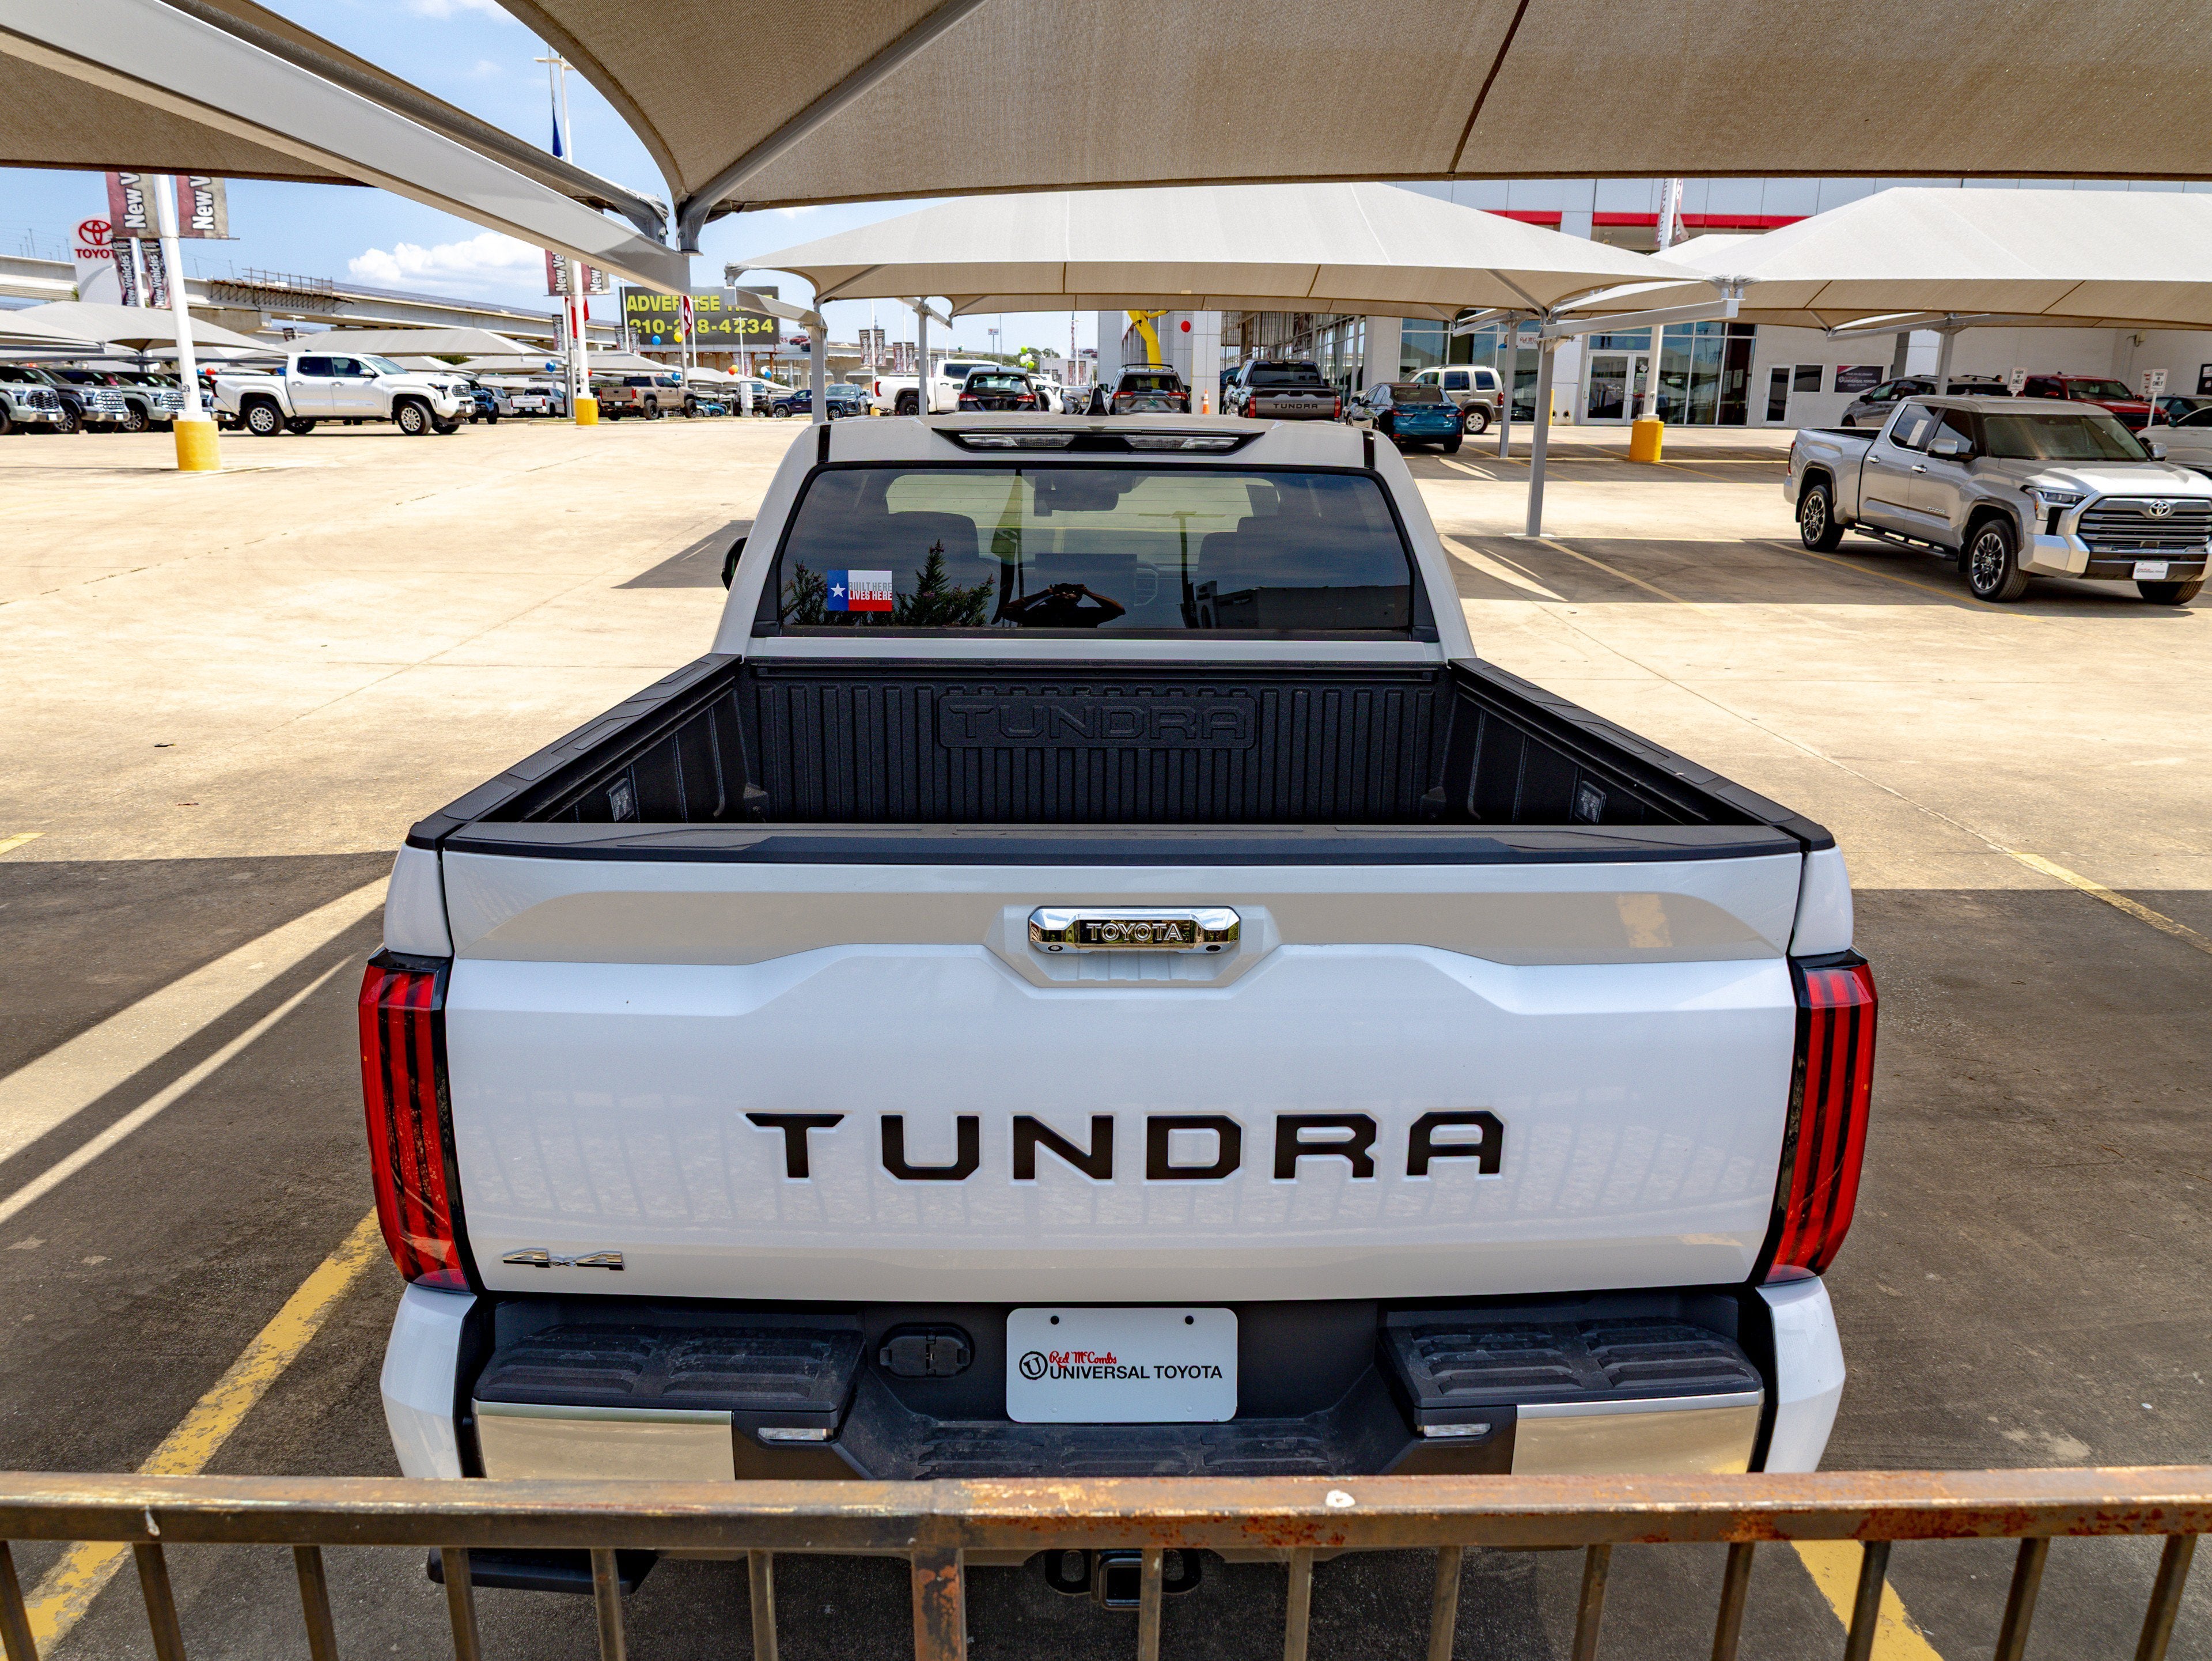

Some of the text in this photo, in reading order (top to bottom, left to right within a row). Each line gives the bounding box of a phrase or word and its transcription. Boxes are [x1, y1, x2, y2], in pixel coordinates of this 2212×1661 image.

[123, 188, 147, 229] New
[191, 190, 215, 230] New
[75, 248, 116, 259] TOYOT
[120, 255, 134, 289] Vehicles
[149, 255, 163, 288] Vehicles
[555, 269, 569, 292] New
[589, 269, 603, 292] New
[126, 289, 137, 306] New
[154, 289, 166, 306] New
[627, 295, 720, 312] ADVERISE
[629, 319, 774, 334] 210-28-4234
[849, 582, 892, 592] BUILT HERE
[849, 591, 892, 600] LIVES HERE
[949, 705, 1245, 739] TUNDRA
[1086, 923, 1183, 941] TOYOTA
[745, 1111, 1504, 1181] TUNDRA
[1049, 1350, 1070, 1368] Red
[1050, 1365, 1222, 1379] UNIVERSAL TOYOTA
